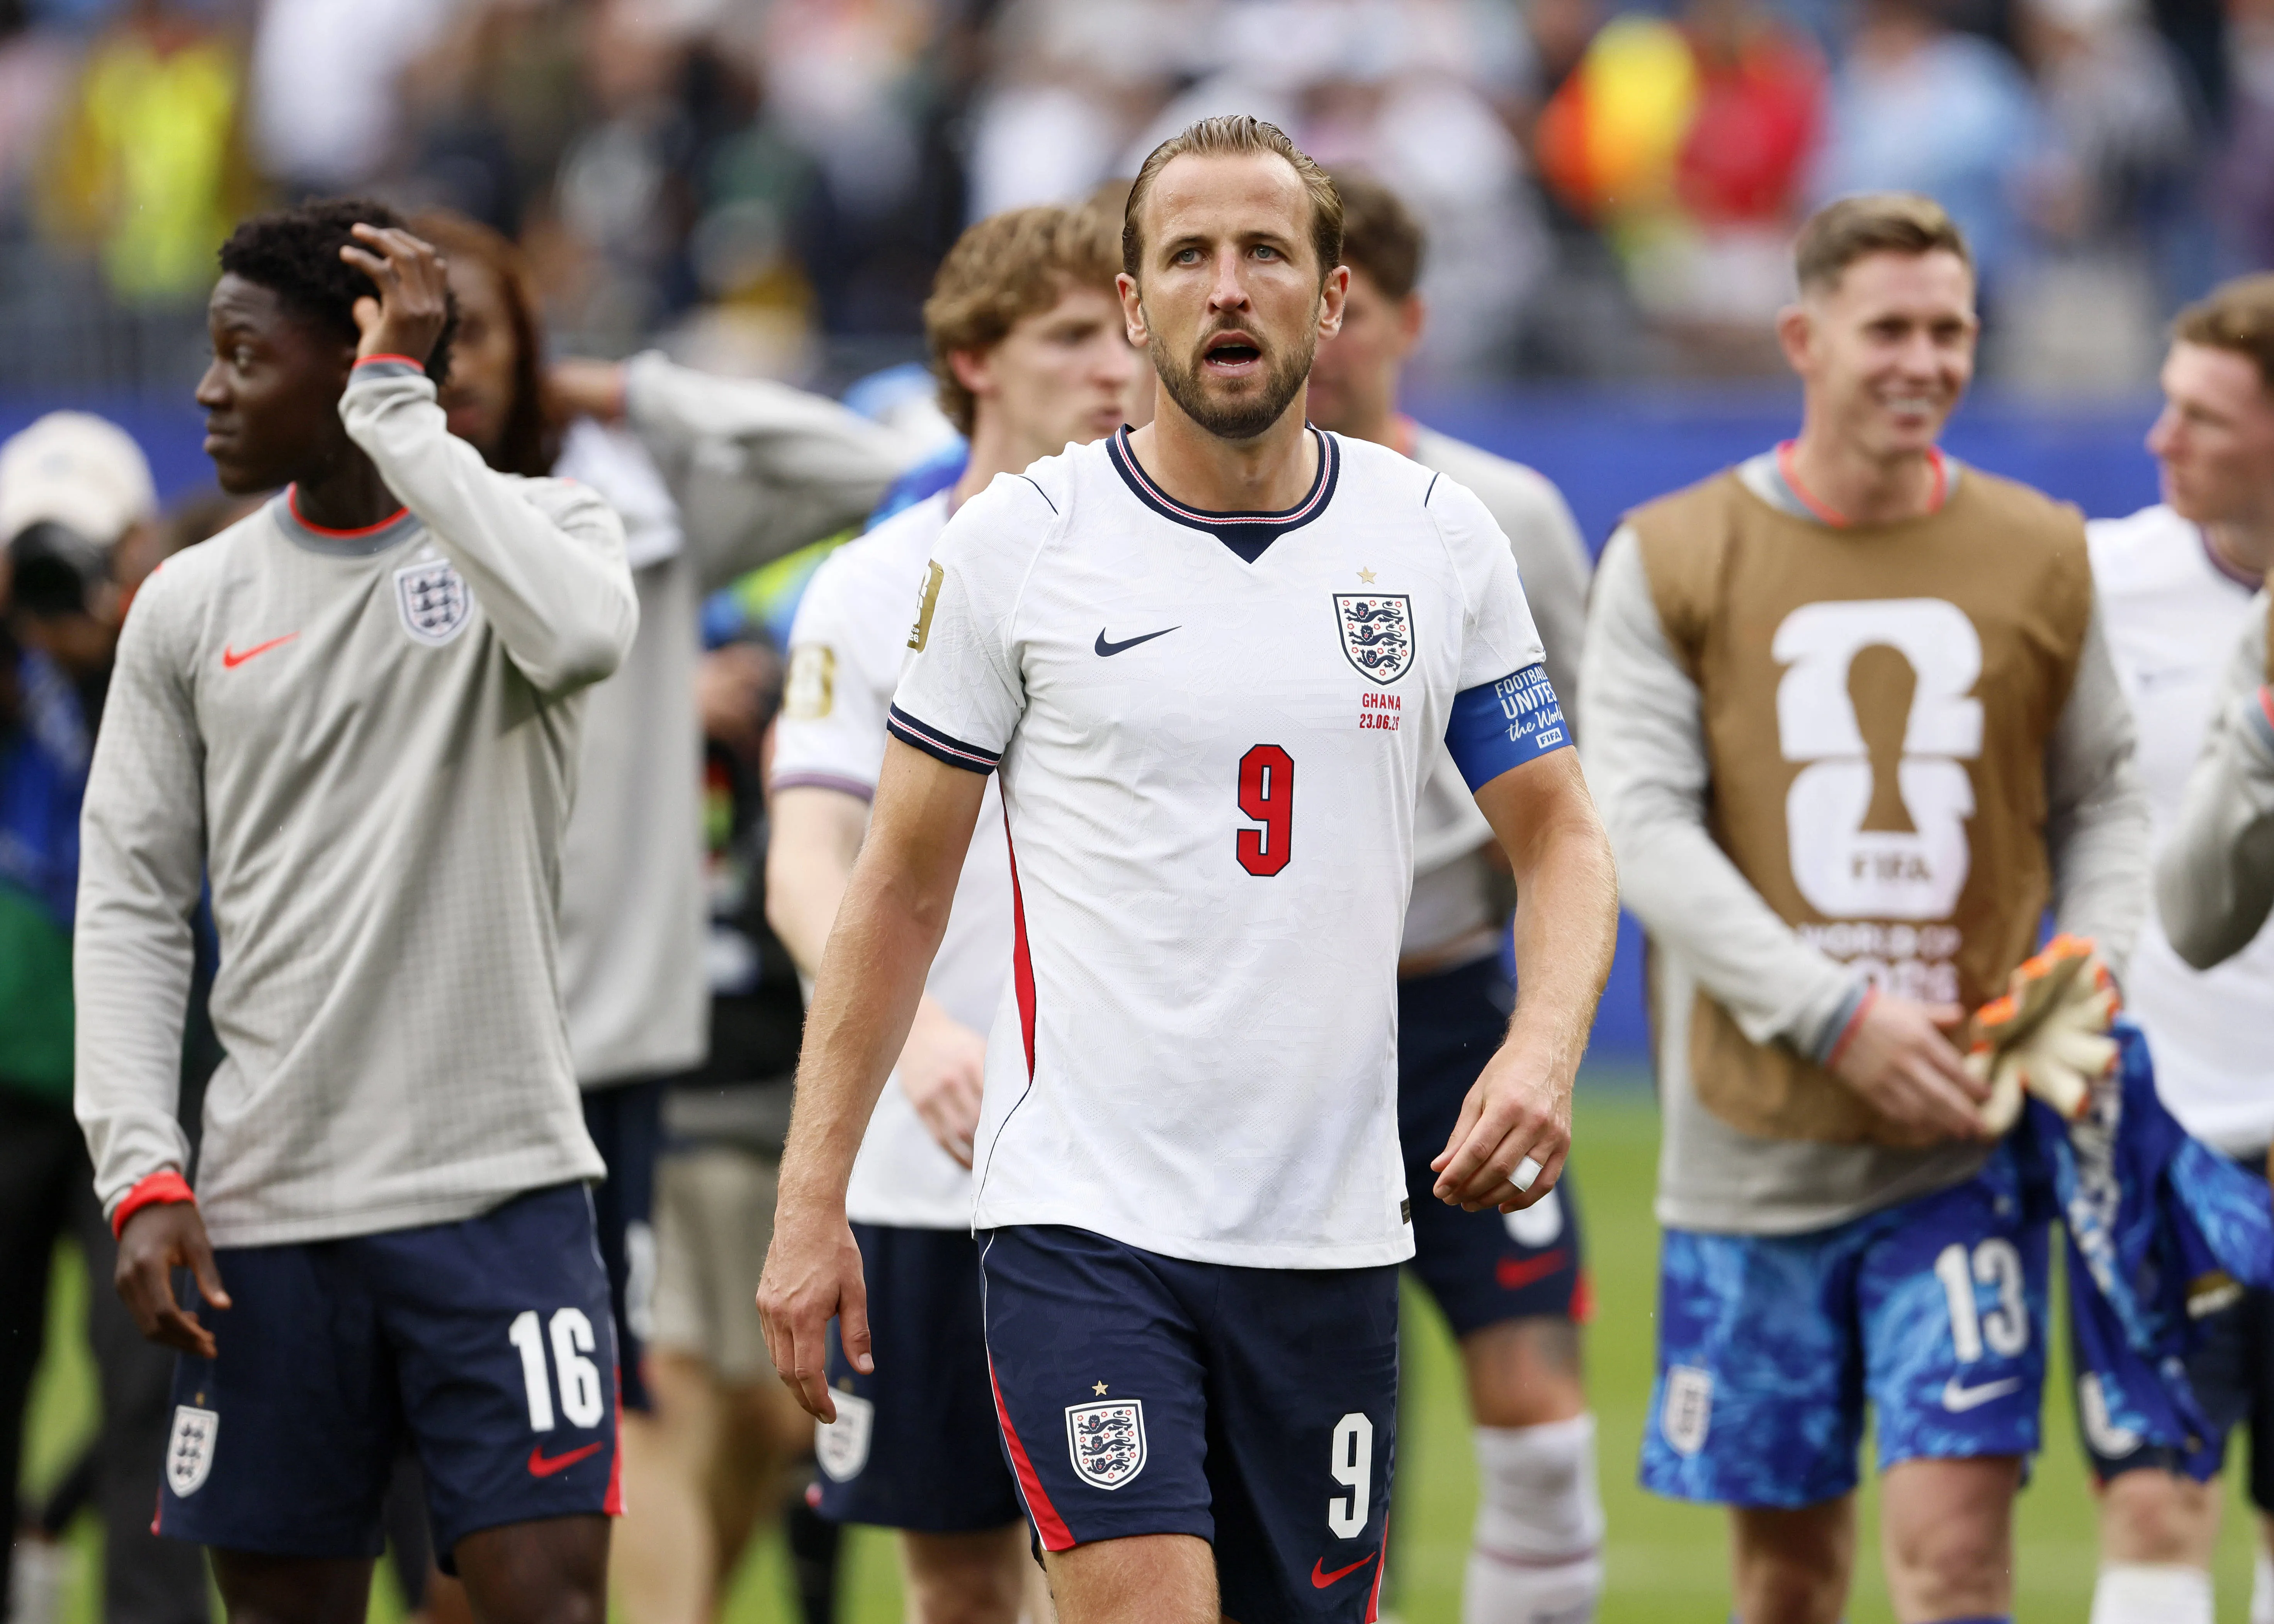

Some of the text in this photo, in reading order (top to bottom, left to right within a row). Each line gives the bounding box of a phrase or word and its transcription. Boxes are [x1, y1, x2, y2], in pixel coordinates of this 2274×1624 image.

[1494, 666, 1548, 698] FOOTBALL
[1501, 681, 1557, 719] UNITES
[1362, 693, 1400, 711] GHANA
[1359, 713, 1400, 731] 23.06.26
[1505, 703, 1565, 742] the World
[1538, 730, 1562, 746] FIFA
[1236, 744, 1294, 877] 9
[1849, 851, 1932, 881] FIFA
[1935, 1242, 2026, 1364] 13
[509, 1307, 604, 1432] 16
[1328, 1412, 1373, 1539] 9
